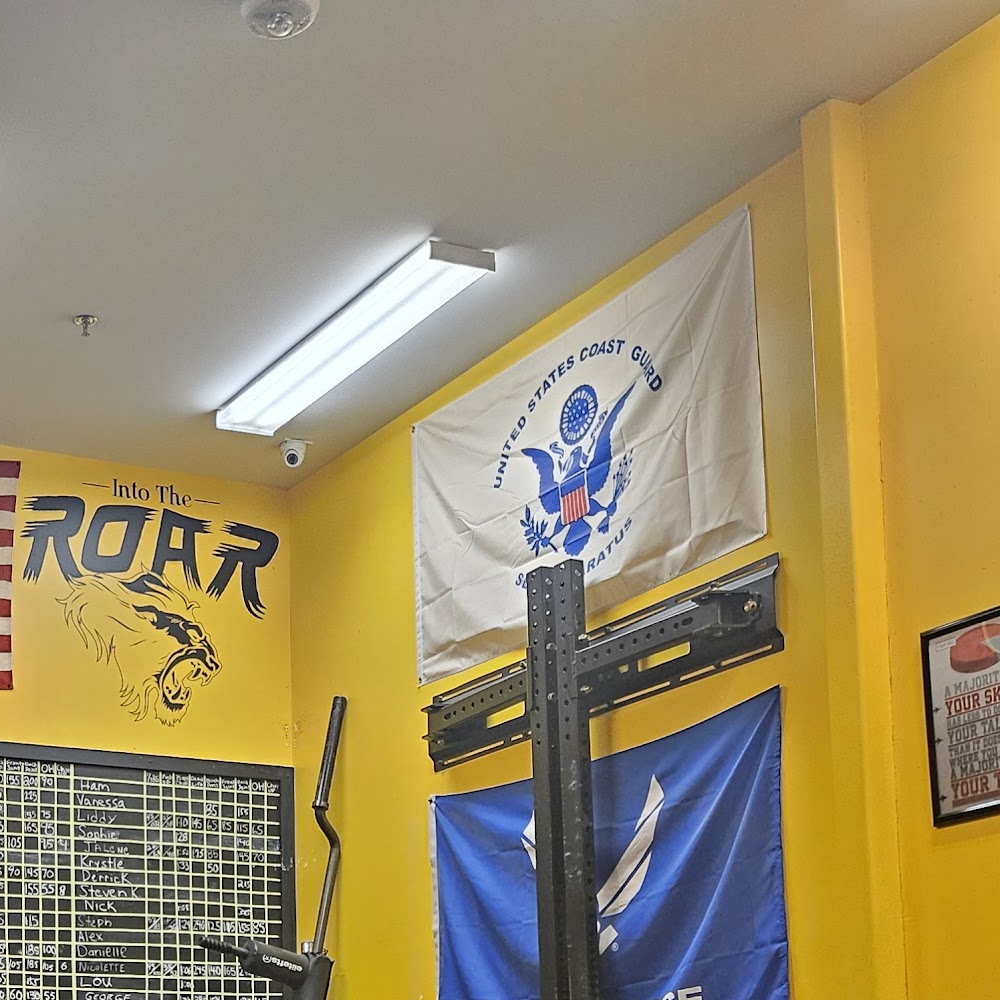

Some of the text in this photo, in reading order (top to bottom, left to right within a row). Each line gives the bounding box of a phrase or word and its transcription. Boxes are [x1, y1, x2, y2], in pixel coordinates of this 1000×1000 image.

[494, 339, 663, 489] UNITED STATES COAST GUARD
[112, 478, 192, 508] Into The
[586, 517, 632, 573] RATUS
[20, 496, 279, 620] ROAR
[944, 669, 1000, 697] A MAJORIT
[945, 693, 980, 716] YOUR
[982, 707, 992, 717] TO
[948, 724, 977, 744] YOUR
[948, 740, 970, 757] THAN
[973, 740, 980, 751] IT
[949, 746, 998, 767] WHERE YOU
[41, 764, 55, 774] OH
[951, 768, 957, 779] A
[80, 781, 110, 793] Ham
[252, 781, 264, 791] OH
[951, 775, 989, 799] YOUR
[76, 793, 126, 809] Vanessa
[77, 808, 117, 825] Liddy
[78, 825, 119, 840] Sophie
[80, 855, 124, 870] Krystle
[79, 885, 127, 899] Steven
[77, 915, 112, 929] Steph
[78, 930, 104, 942] Alex
[77, 945, 128, 958] Danielle
